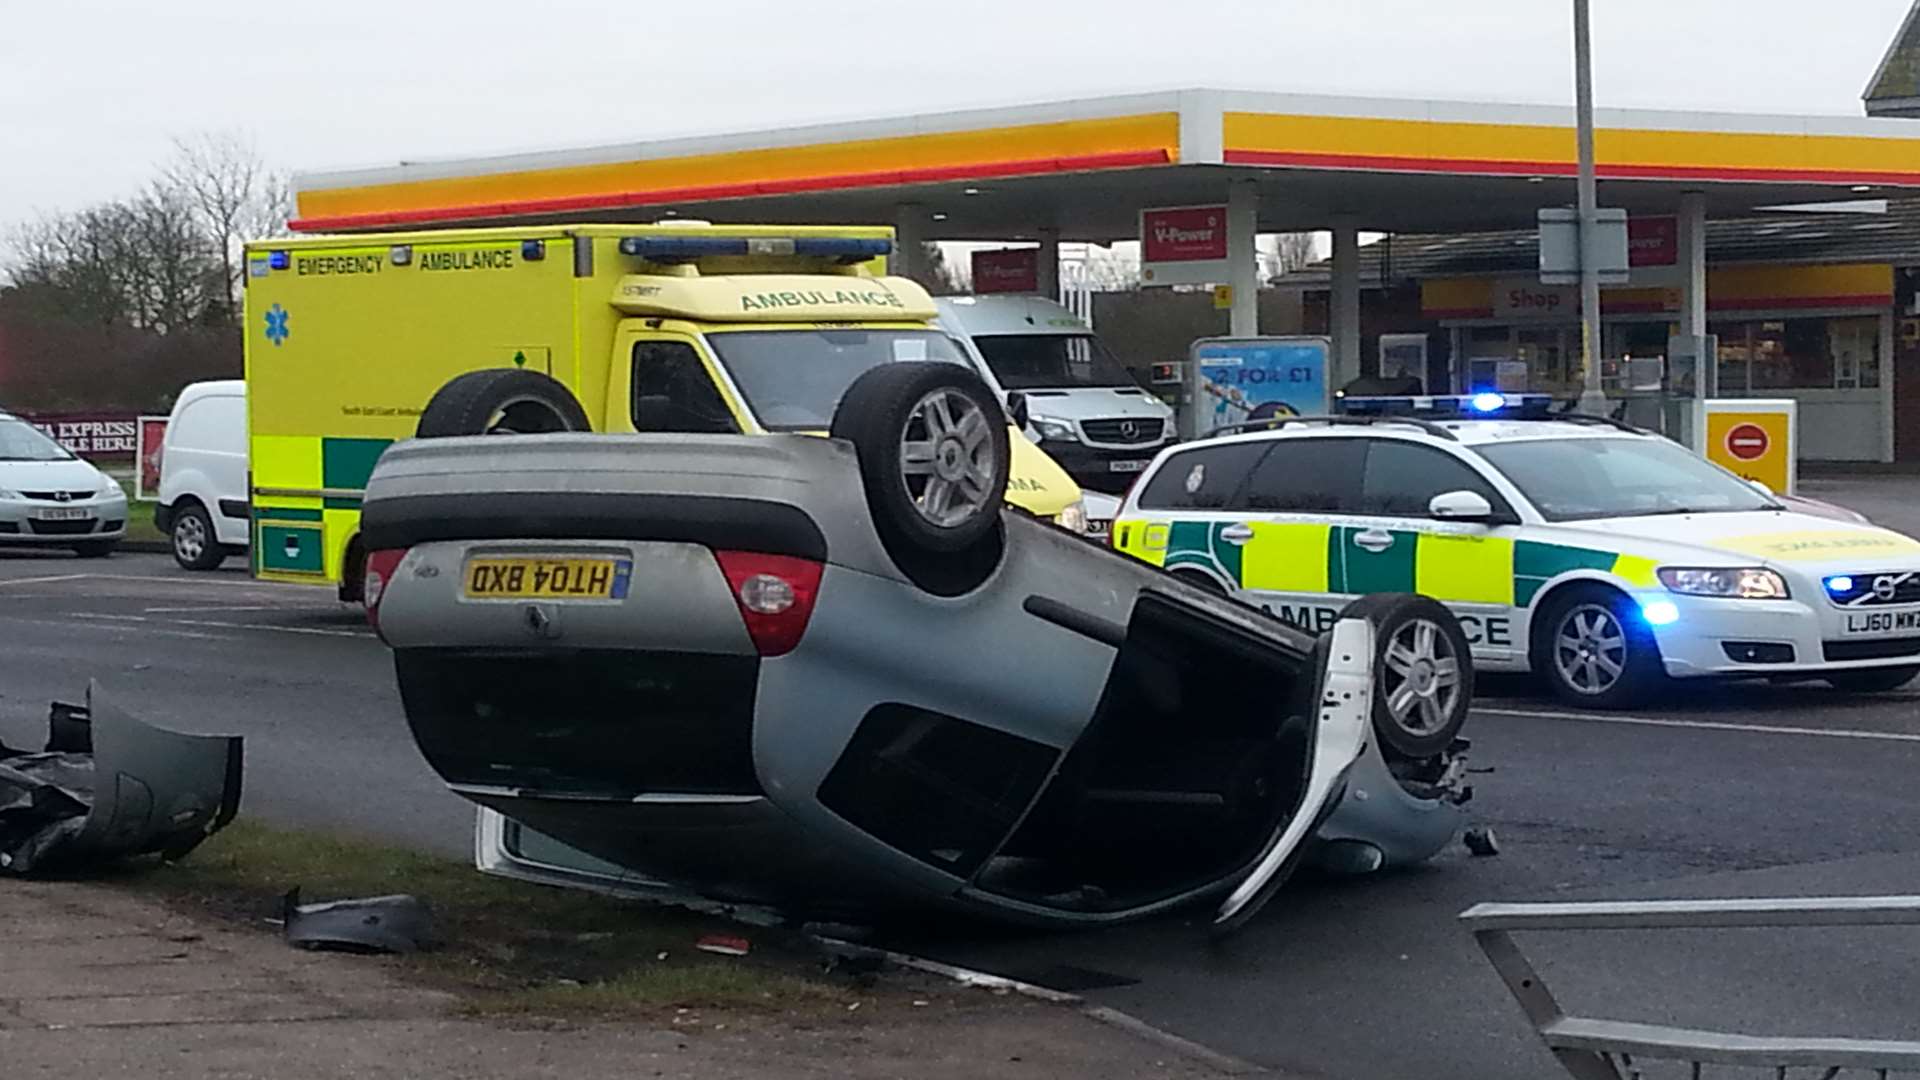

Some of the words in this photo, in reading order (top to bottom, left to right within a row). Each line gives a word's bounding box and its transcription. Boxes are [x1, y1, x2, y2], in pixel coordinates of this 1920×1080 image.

[1155, 227, 1213, 243] V-Power
[297, 255, 383, 276] EMERGENCY
[420, 250, 513, 271] AMBULANCE
[741, 290, 905, 311] AMBULANCE
[1509, 289, 1560, 309] Shop
[1216, 368, 1230, 384] 2
[1238, 367, 1280, 384] FOR
[1289, 366, 1312, 382] £1
[59, 421, 136, 437] EXPRESS
[93, 438, 137, 451] HERE
[472, 565, 525, 593] BXD
[533, 565, 610, 594] HT04
[1847, 613, 1892, 633] LJ60
